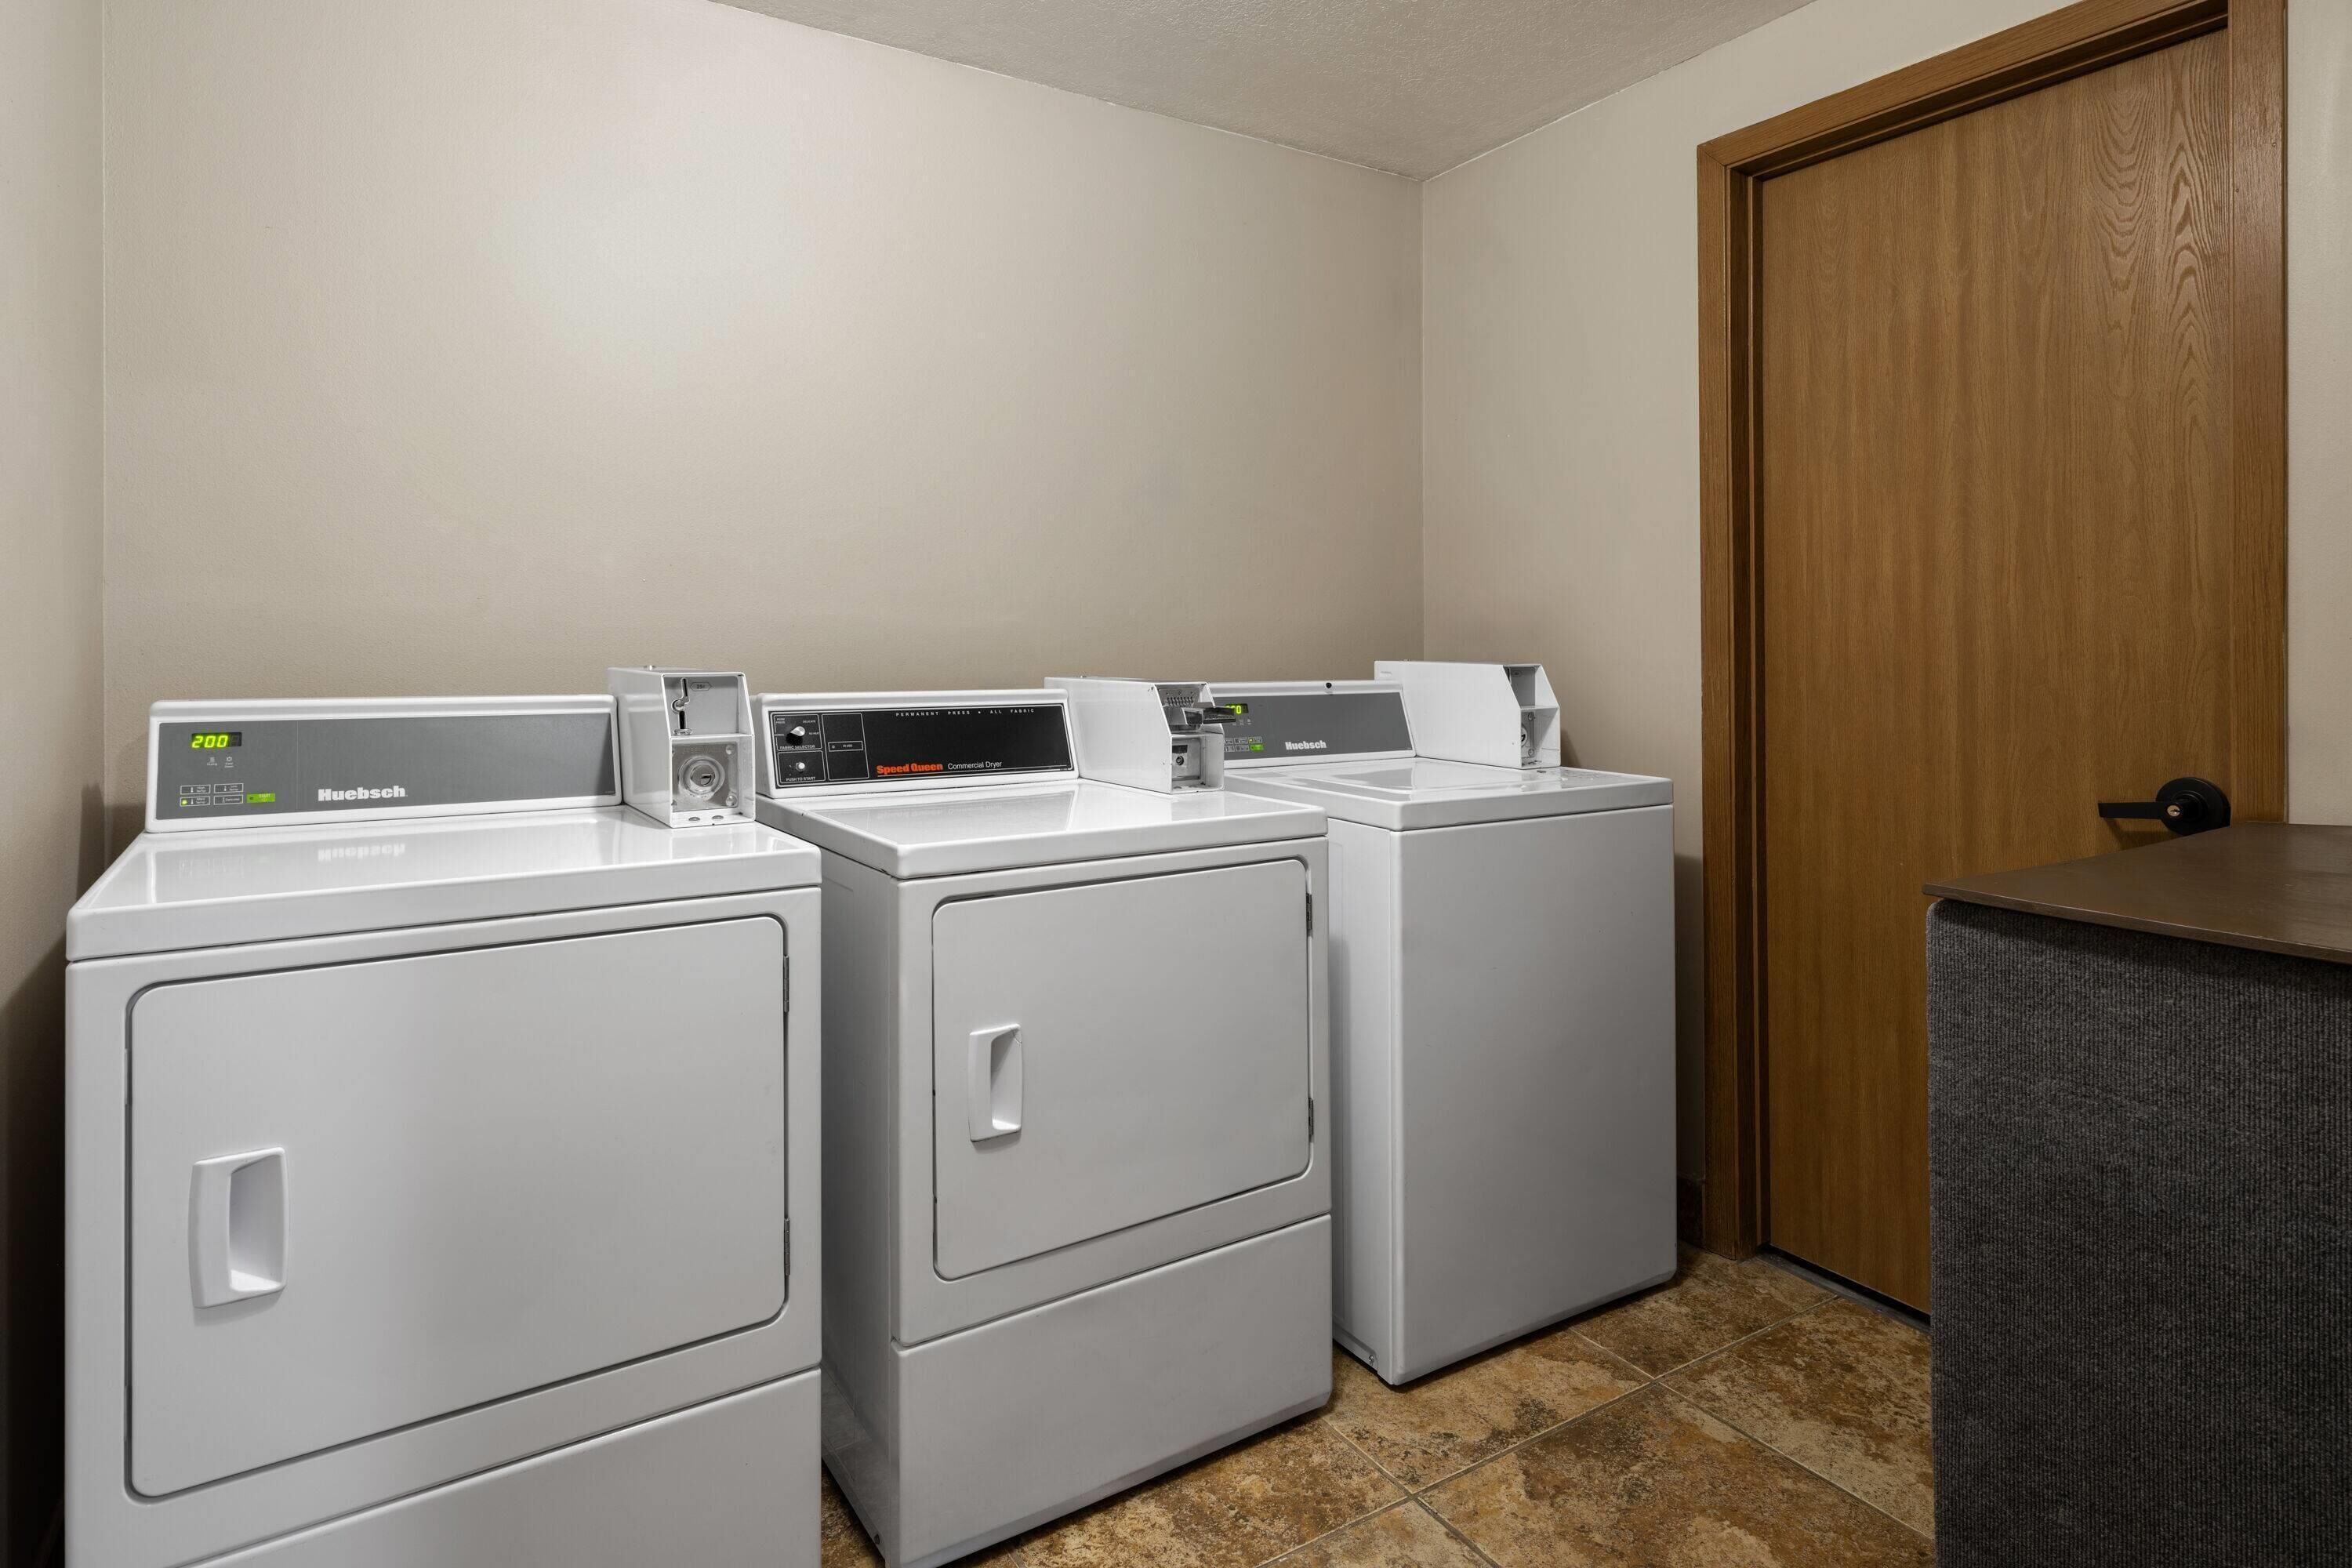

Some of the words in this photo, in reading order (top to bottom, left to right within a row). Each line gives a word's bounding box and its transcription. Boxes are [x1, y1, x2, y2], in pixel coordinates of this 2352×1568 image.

[191, 735, 229, 748] 200
[1284, 740, 1327, 750] Huebsch
[877, 764, 909, 775] Speed
[911, 763, 943, 772] Queen
[947, 761, 985, 770] Commercial
[985, 760, 1003, 769] Dryer
[318, 786, 406, 801] Huebsch
